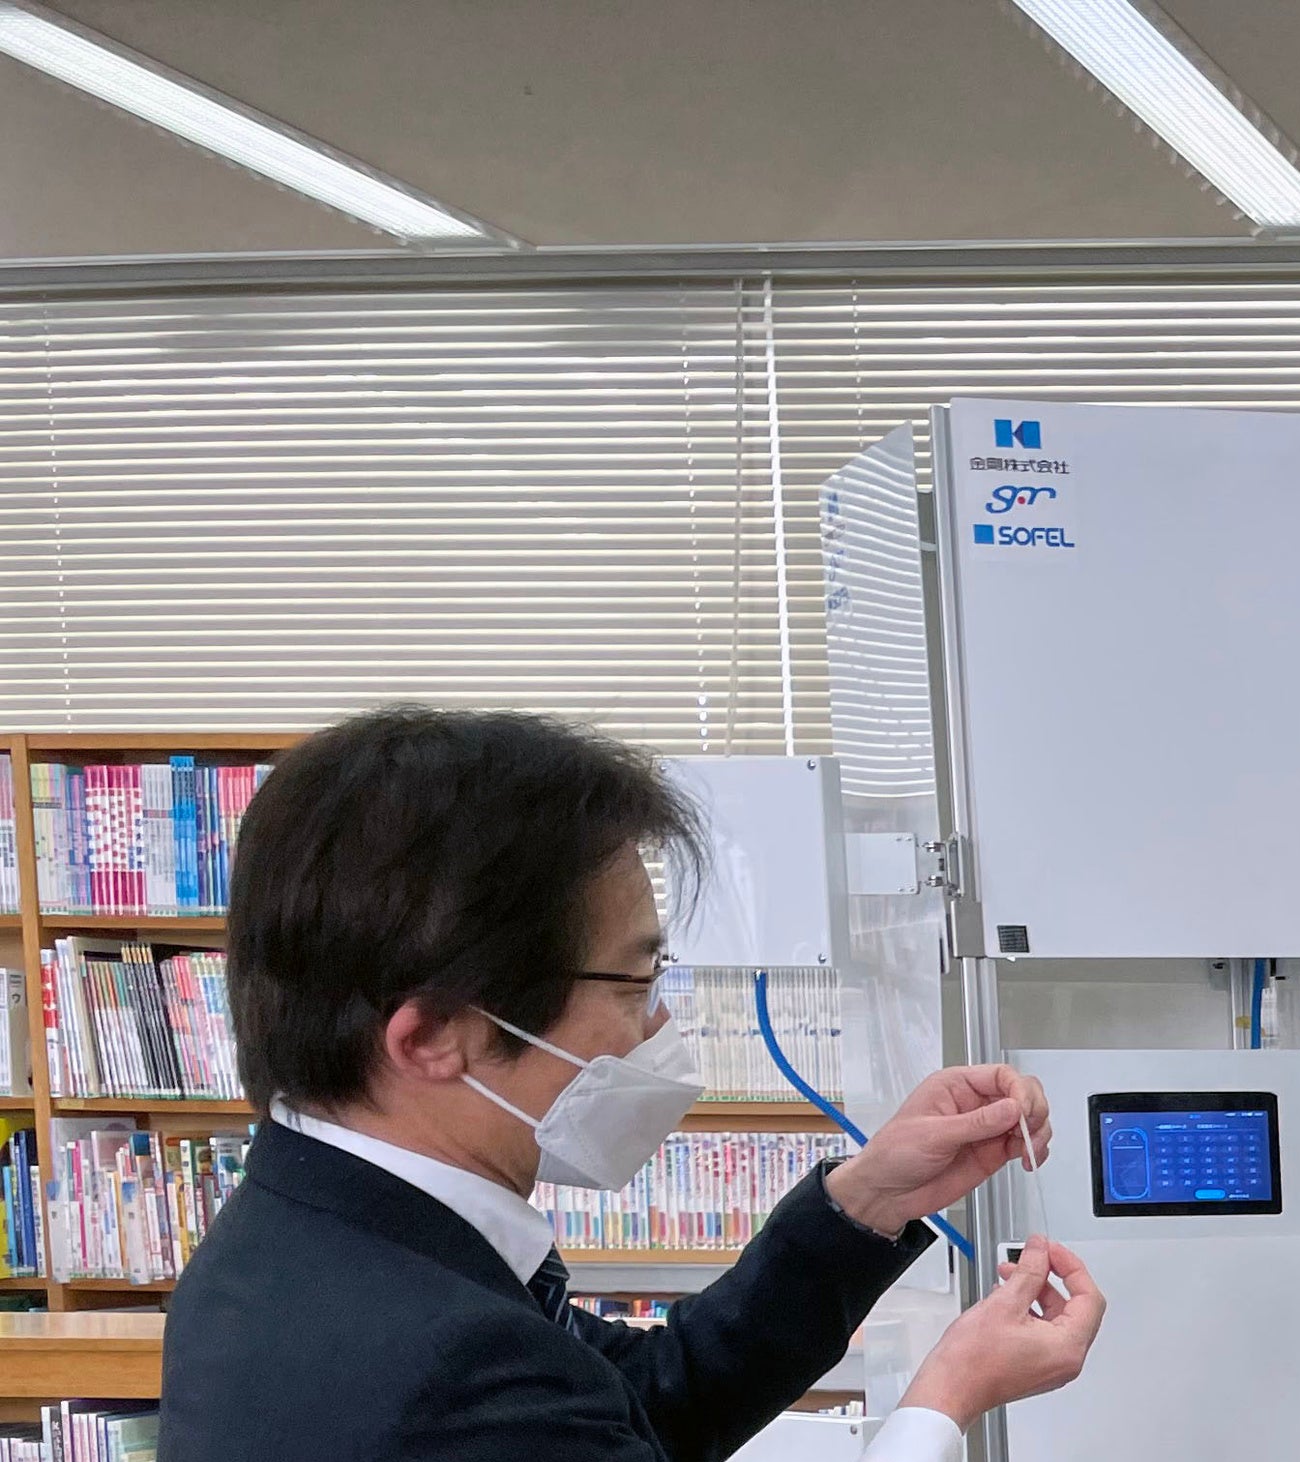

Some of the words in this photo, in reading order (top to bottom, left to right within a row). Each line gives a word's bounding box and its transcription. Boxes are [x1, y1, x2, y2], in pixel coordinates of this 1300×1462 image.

[969, 456, 1070, 474] 金剛株式会社
[998, 525, 1075, 548] SOFEL
